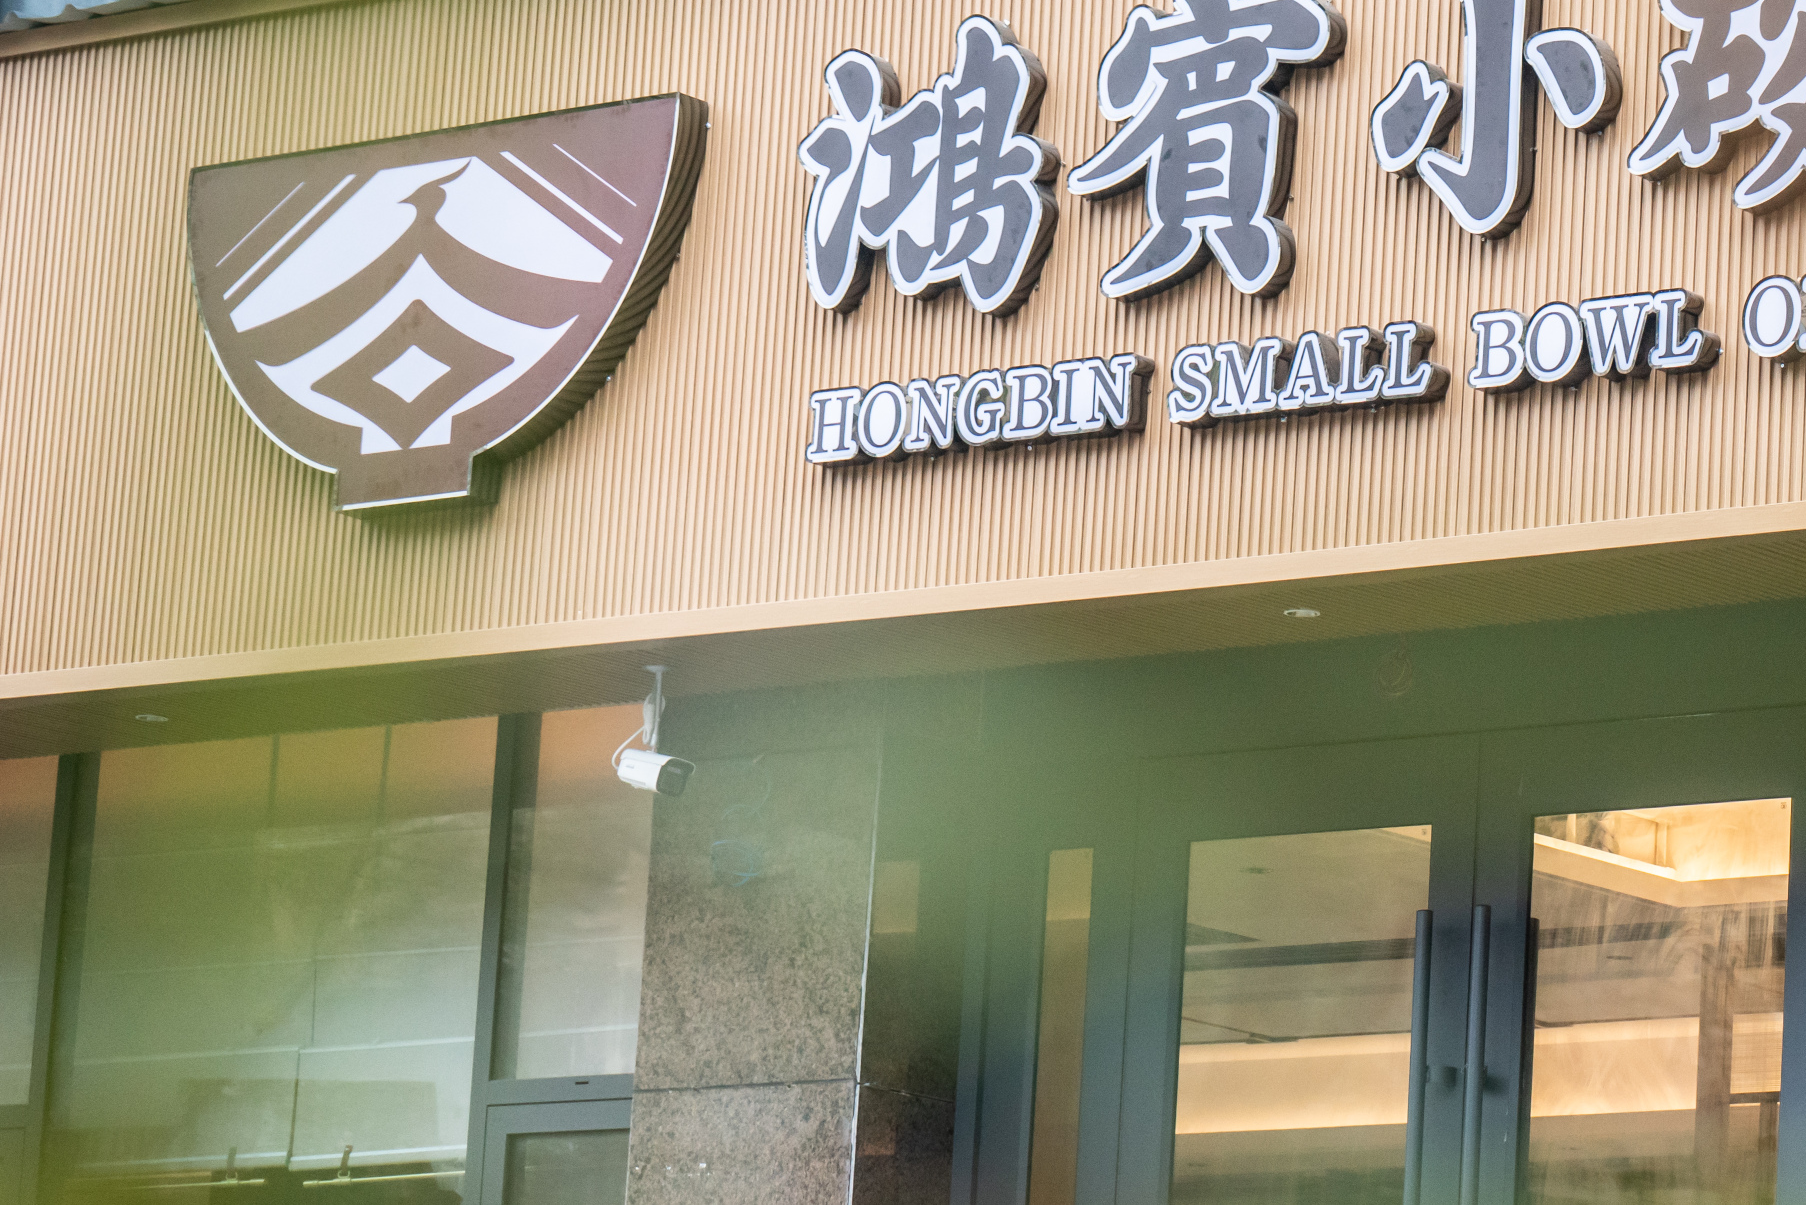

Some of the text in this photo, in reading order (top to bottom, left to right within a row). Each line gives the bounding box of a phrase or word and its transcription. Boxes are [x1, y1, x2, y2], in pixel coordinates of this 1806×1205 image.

[806, 353, 1137, 463] HONGBIN
[1168, 320, 1433, 424] SMALL
[1467, 288, 1705, 390] BOWL
